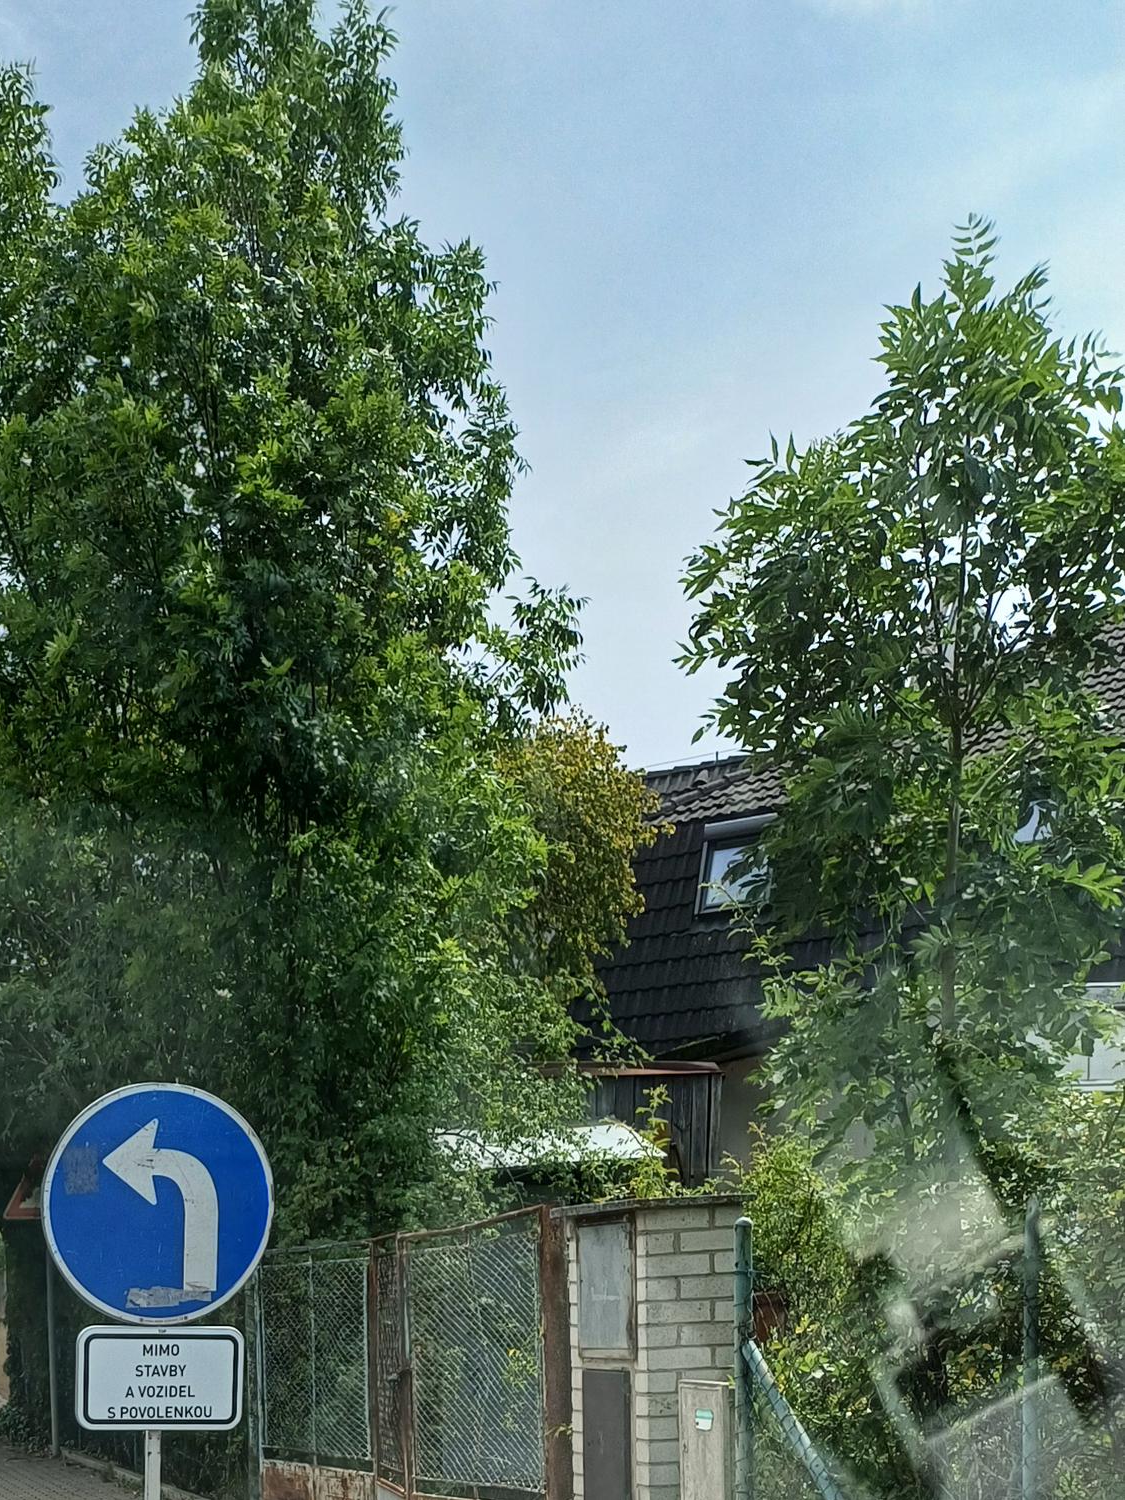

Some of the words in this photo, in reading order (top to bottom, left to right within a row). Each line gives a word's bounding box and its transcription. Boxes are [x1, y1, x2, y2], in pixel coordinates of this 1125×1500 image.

[142, 1344, 180, 1356] MIMO
[135, 1365, 187, 1377] STAVBY
[125, 1386, 135, 1398] A
[138, 1386, 196, 1398] VOZIDEL
[107, 1406, 116, 1419] S
[120, 1406, 213, 1419] POVOLENKOU
